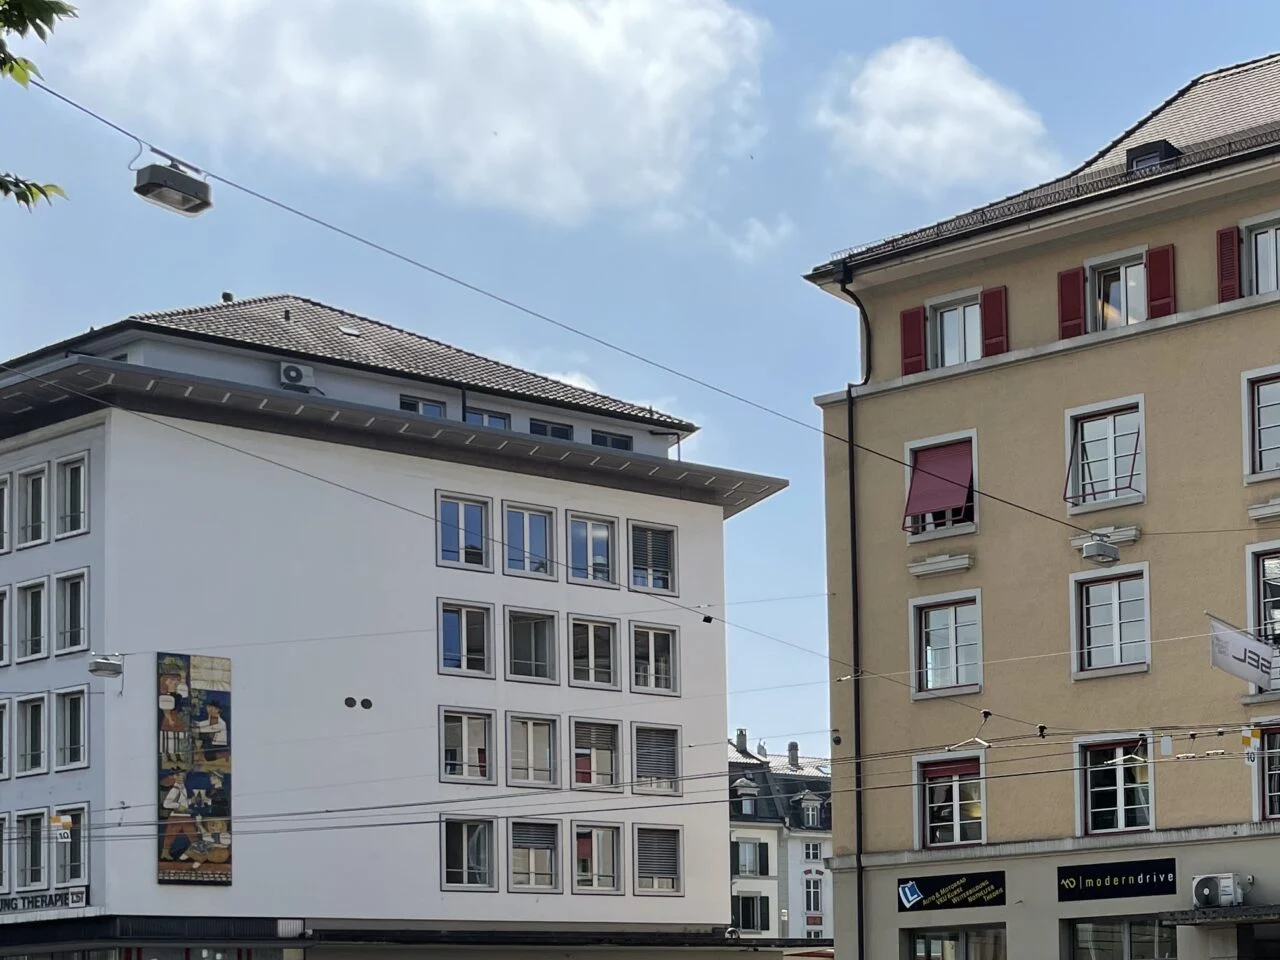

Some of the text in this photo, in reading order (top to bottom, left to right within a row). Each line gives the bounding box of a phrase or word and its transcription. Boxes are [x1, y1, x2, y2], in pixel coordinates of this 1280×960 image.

[59, 831, 69, 839] 10
[1085, 872, 1174, 888] moderndrive
[21, 893, 69, 910] THERAPIE
